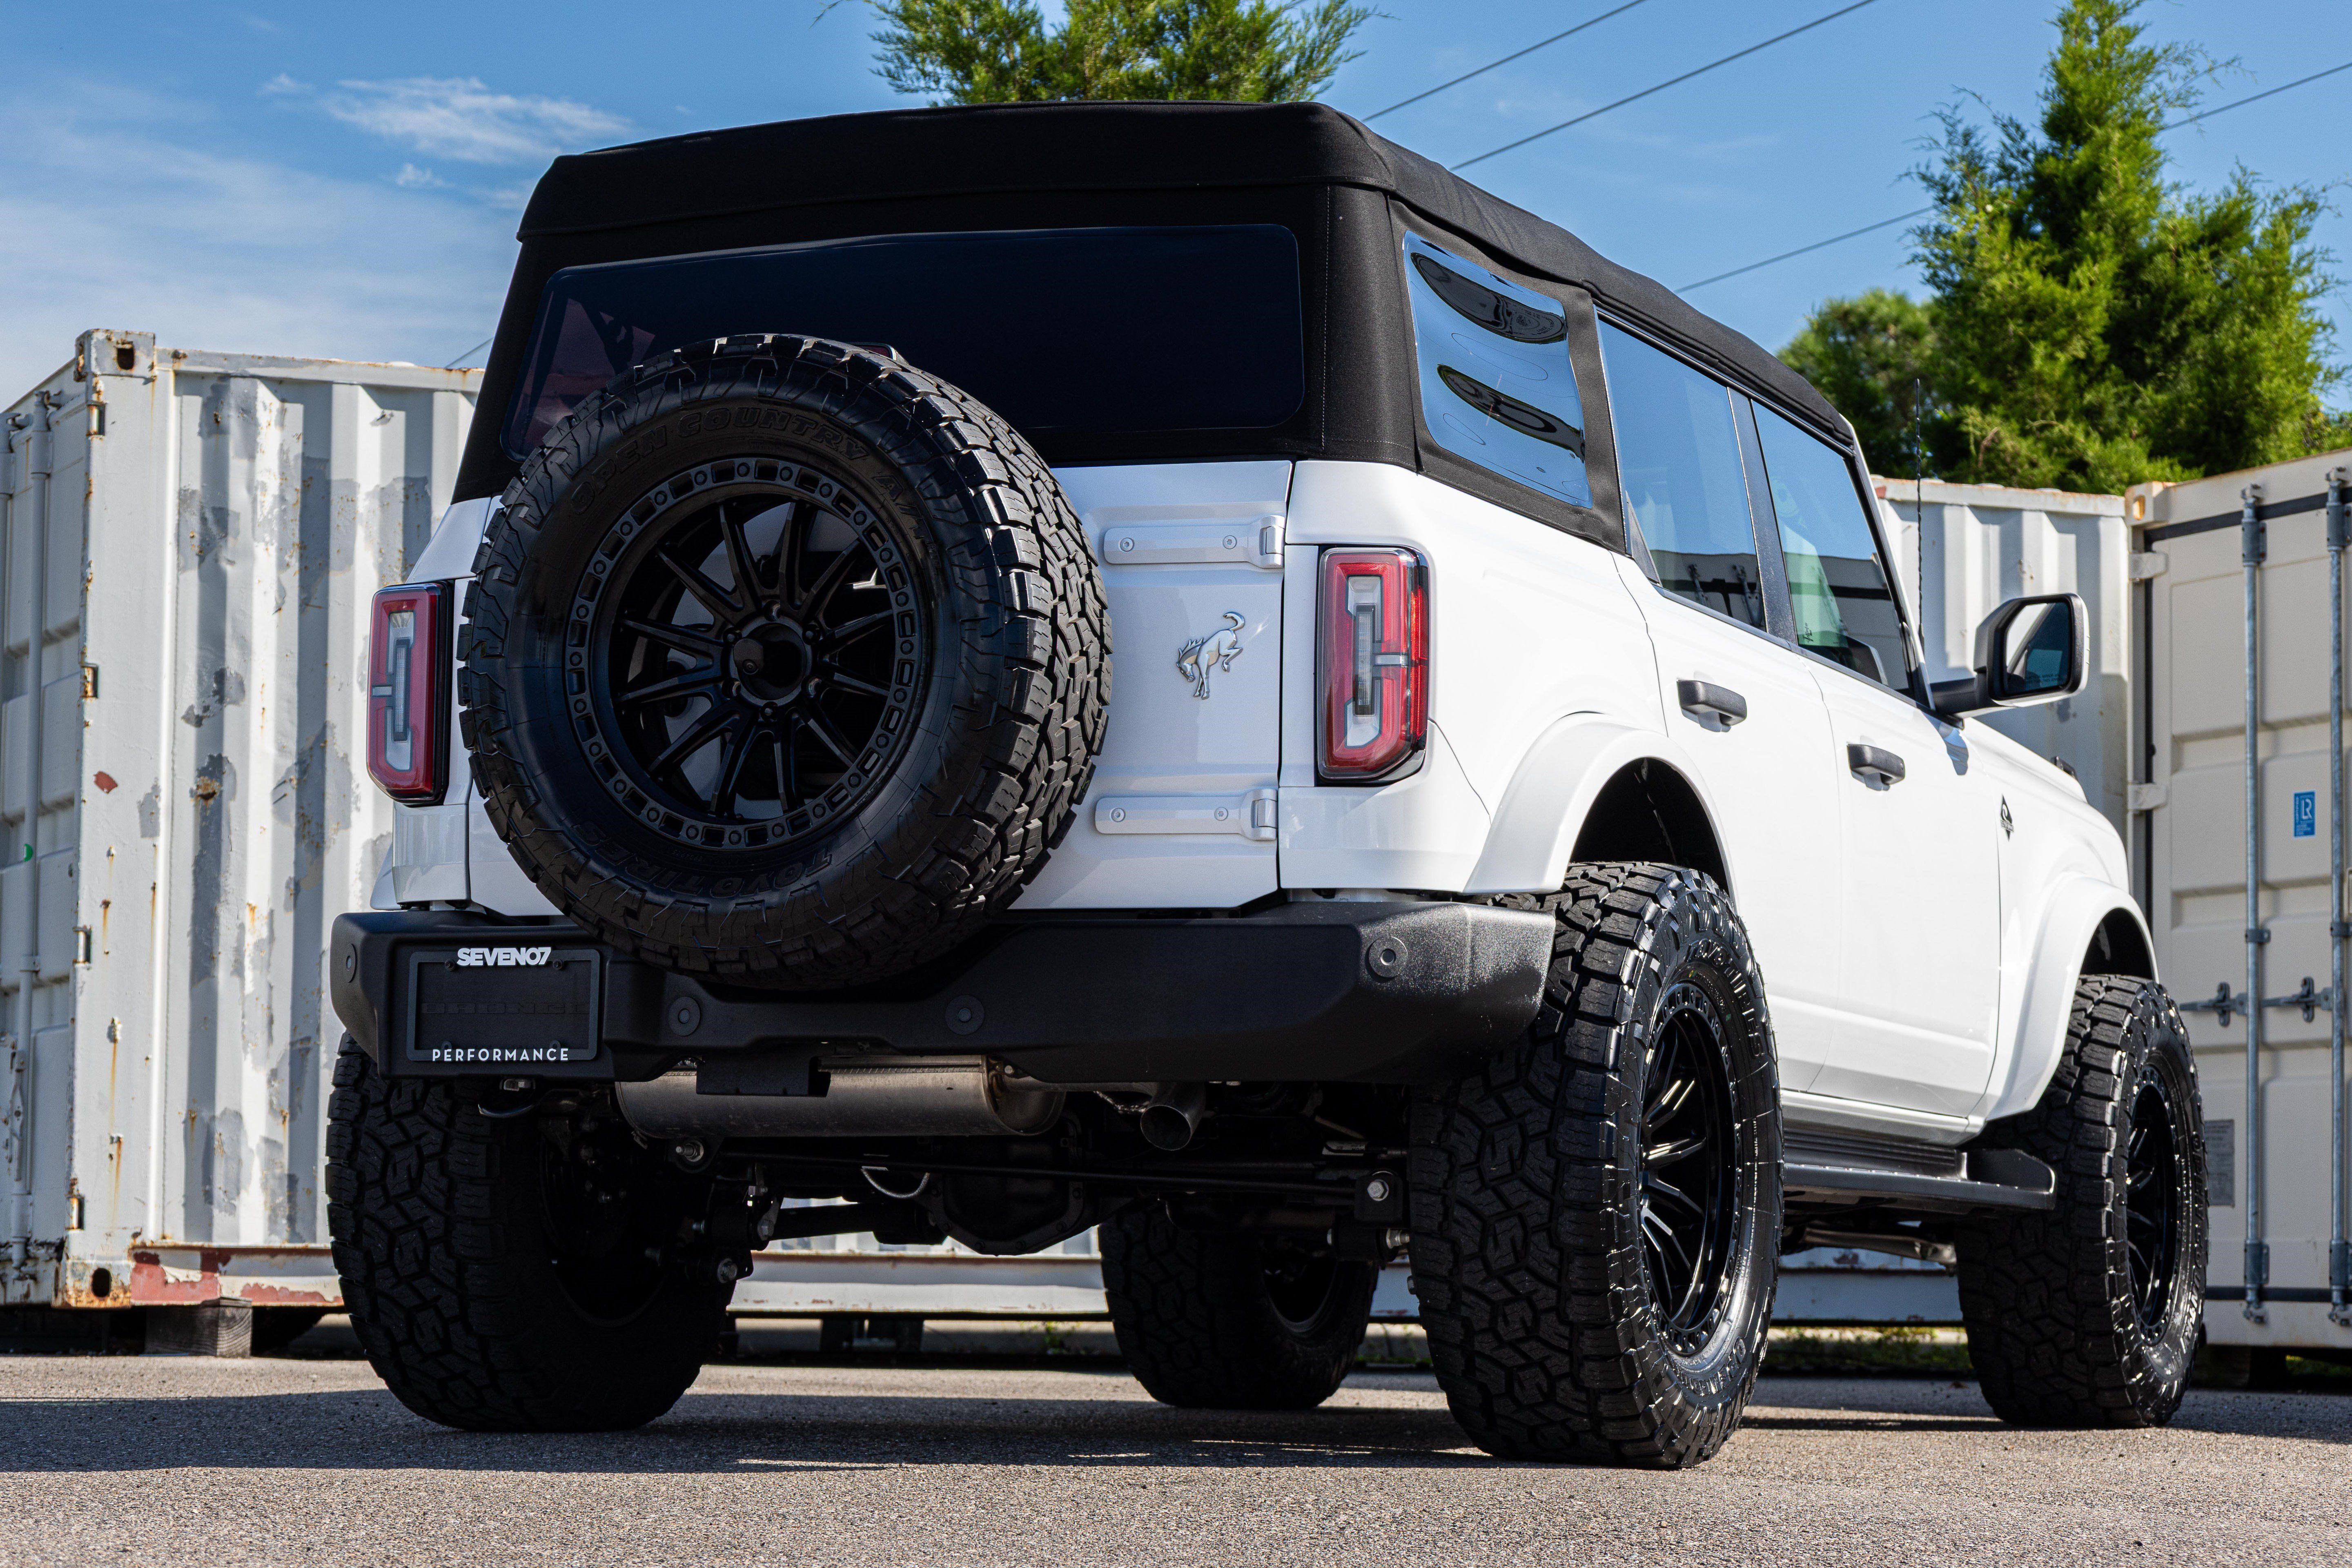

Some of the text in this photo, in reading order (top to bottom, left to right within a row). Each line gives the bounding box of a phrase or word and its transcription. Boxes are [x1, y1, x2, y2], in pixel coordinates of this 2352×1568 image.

[570, 425, 668, 514] OPEN
[678, 407, 870, 461] COUNTRY
[571, 820, 832, 898] TOYO TIRES
[432, 1048, 569, 1062] PERFORMANCE
